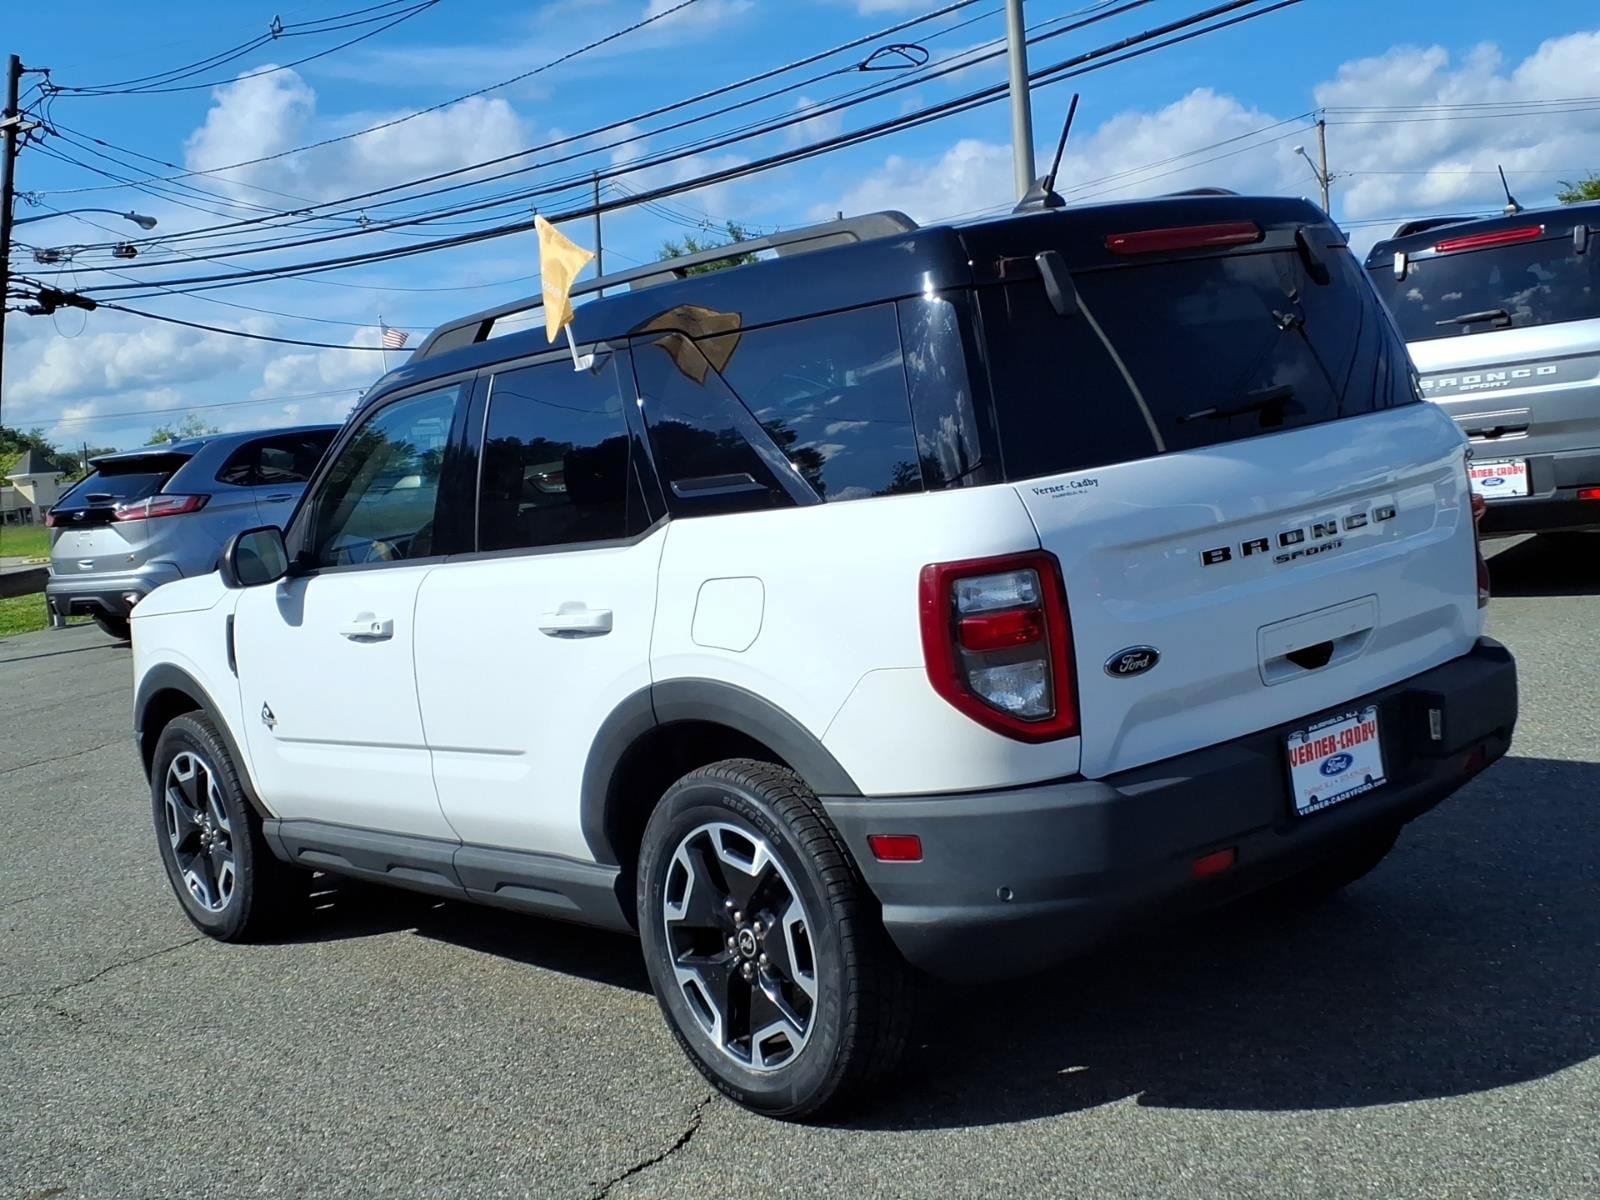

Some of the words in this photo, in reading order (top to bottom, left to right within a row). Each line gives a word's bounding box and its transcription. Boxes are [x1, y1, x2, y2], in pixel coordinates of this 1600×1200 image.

[1419, 365, 1557, 389] BRONCO
[1459, 380, 1511, 391] SPORT
[1200, 504, 1396, 566] BRONCO
[1273, 538, 1344, 564] SPORT
[1119, 652, 1150, 673] Ford
[1289, 719, 1377, 768] VERNER-CADBY
[1325, 756, 1348, 774] Ford
